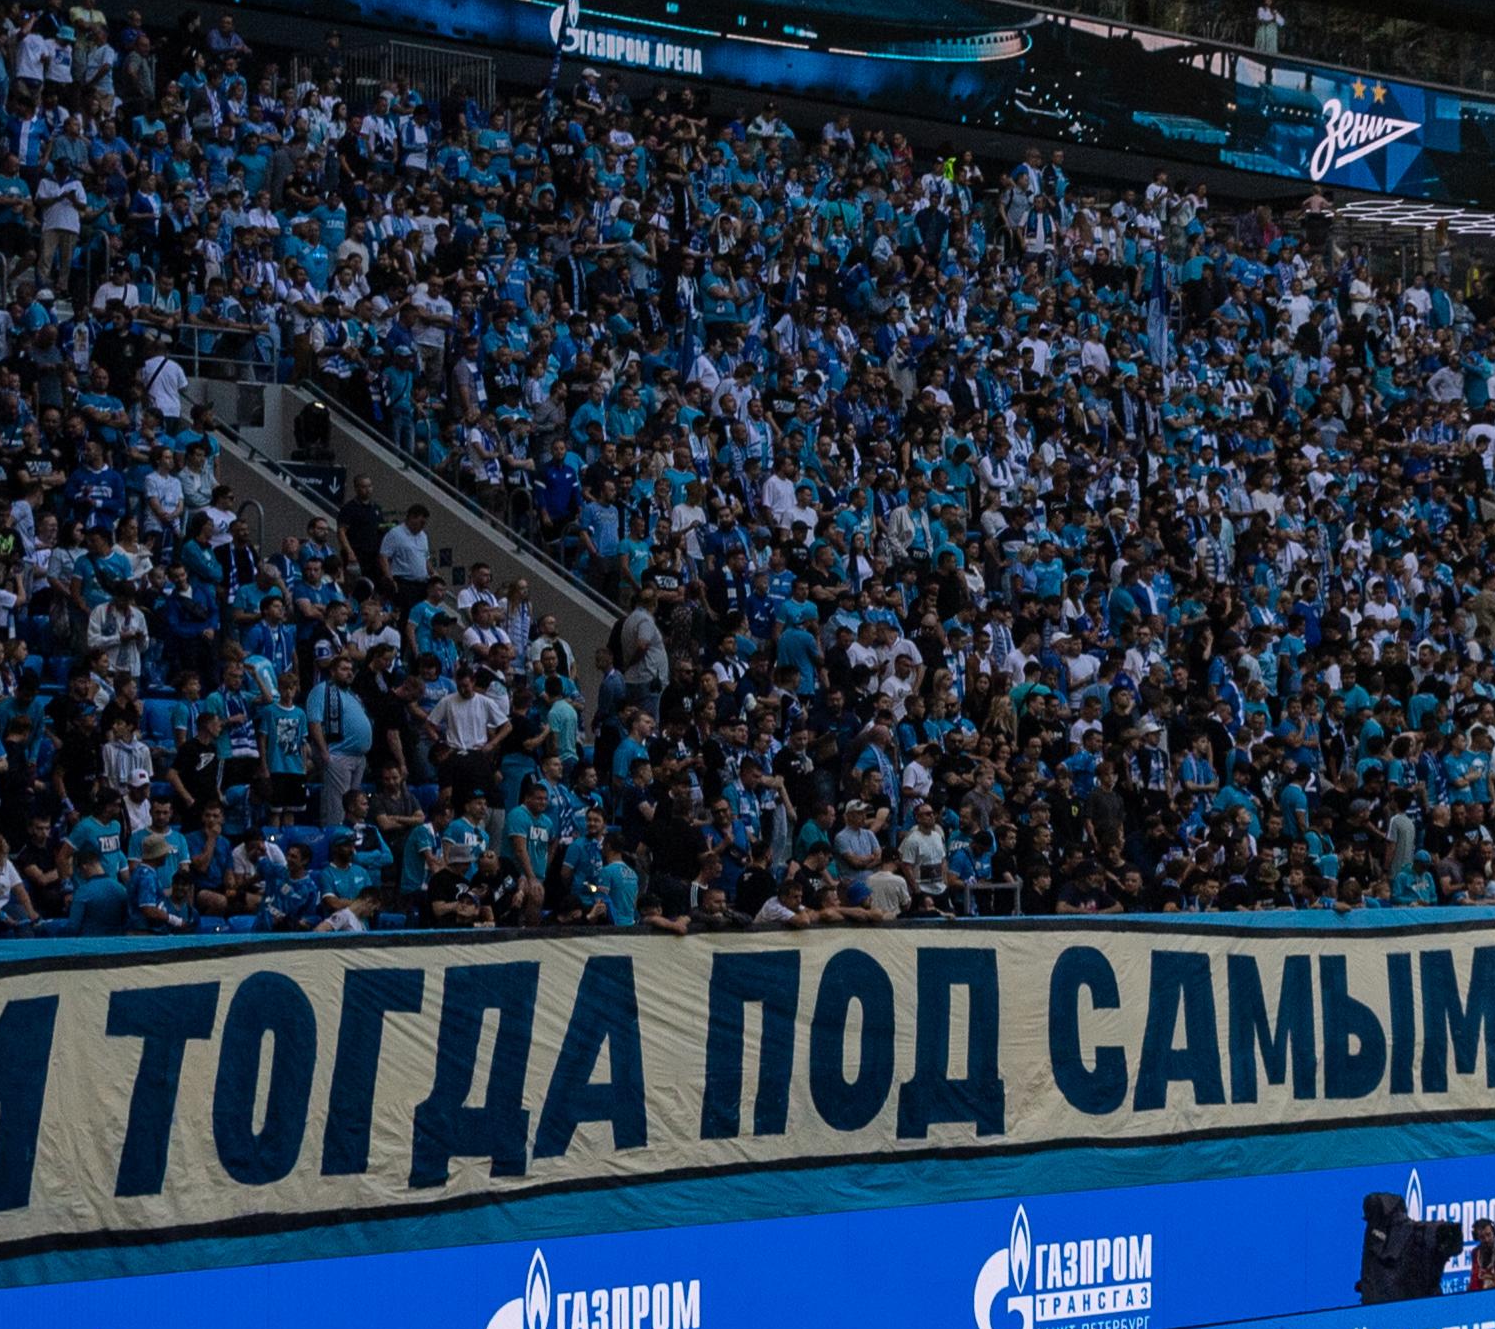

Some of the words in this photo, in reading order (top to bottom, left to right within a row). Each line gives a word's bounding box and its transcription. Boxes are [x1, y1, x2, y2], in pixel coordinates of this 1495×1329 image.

[579, 30, 651, 66] ГАЗПРОМ
[655, 42, 703, 75] АРЕНА
[1310, 98, 1423, 182] Зенит
[106, 954, 649, 1198] ТОГДА
[701, 946, 1007, 1141] ПОД
[1035, 1233, 1153, 1283] ГАЗПРОМ
[1038, 1280, 1151, 1317] ТРАНСГАЗ
